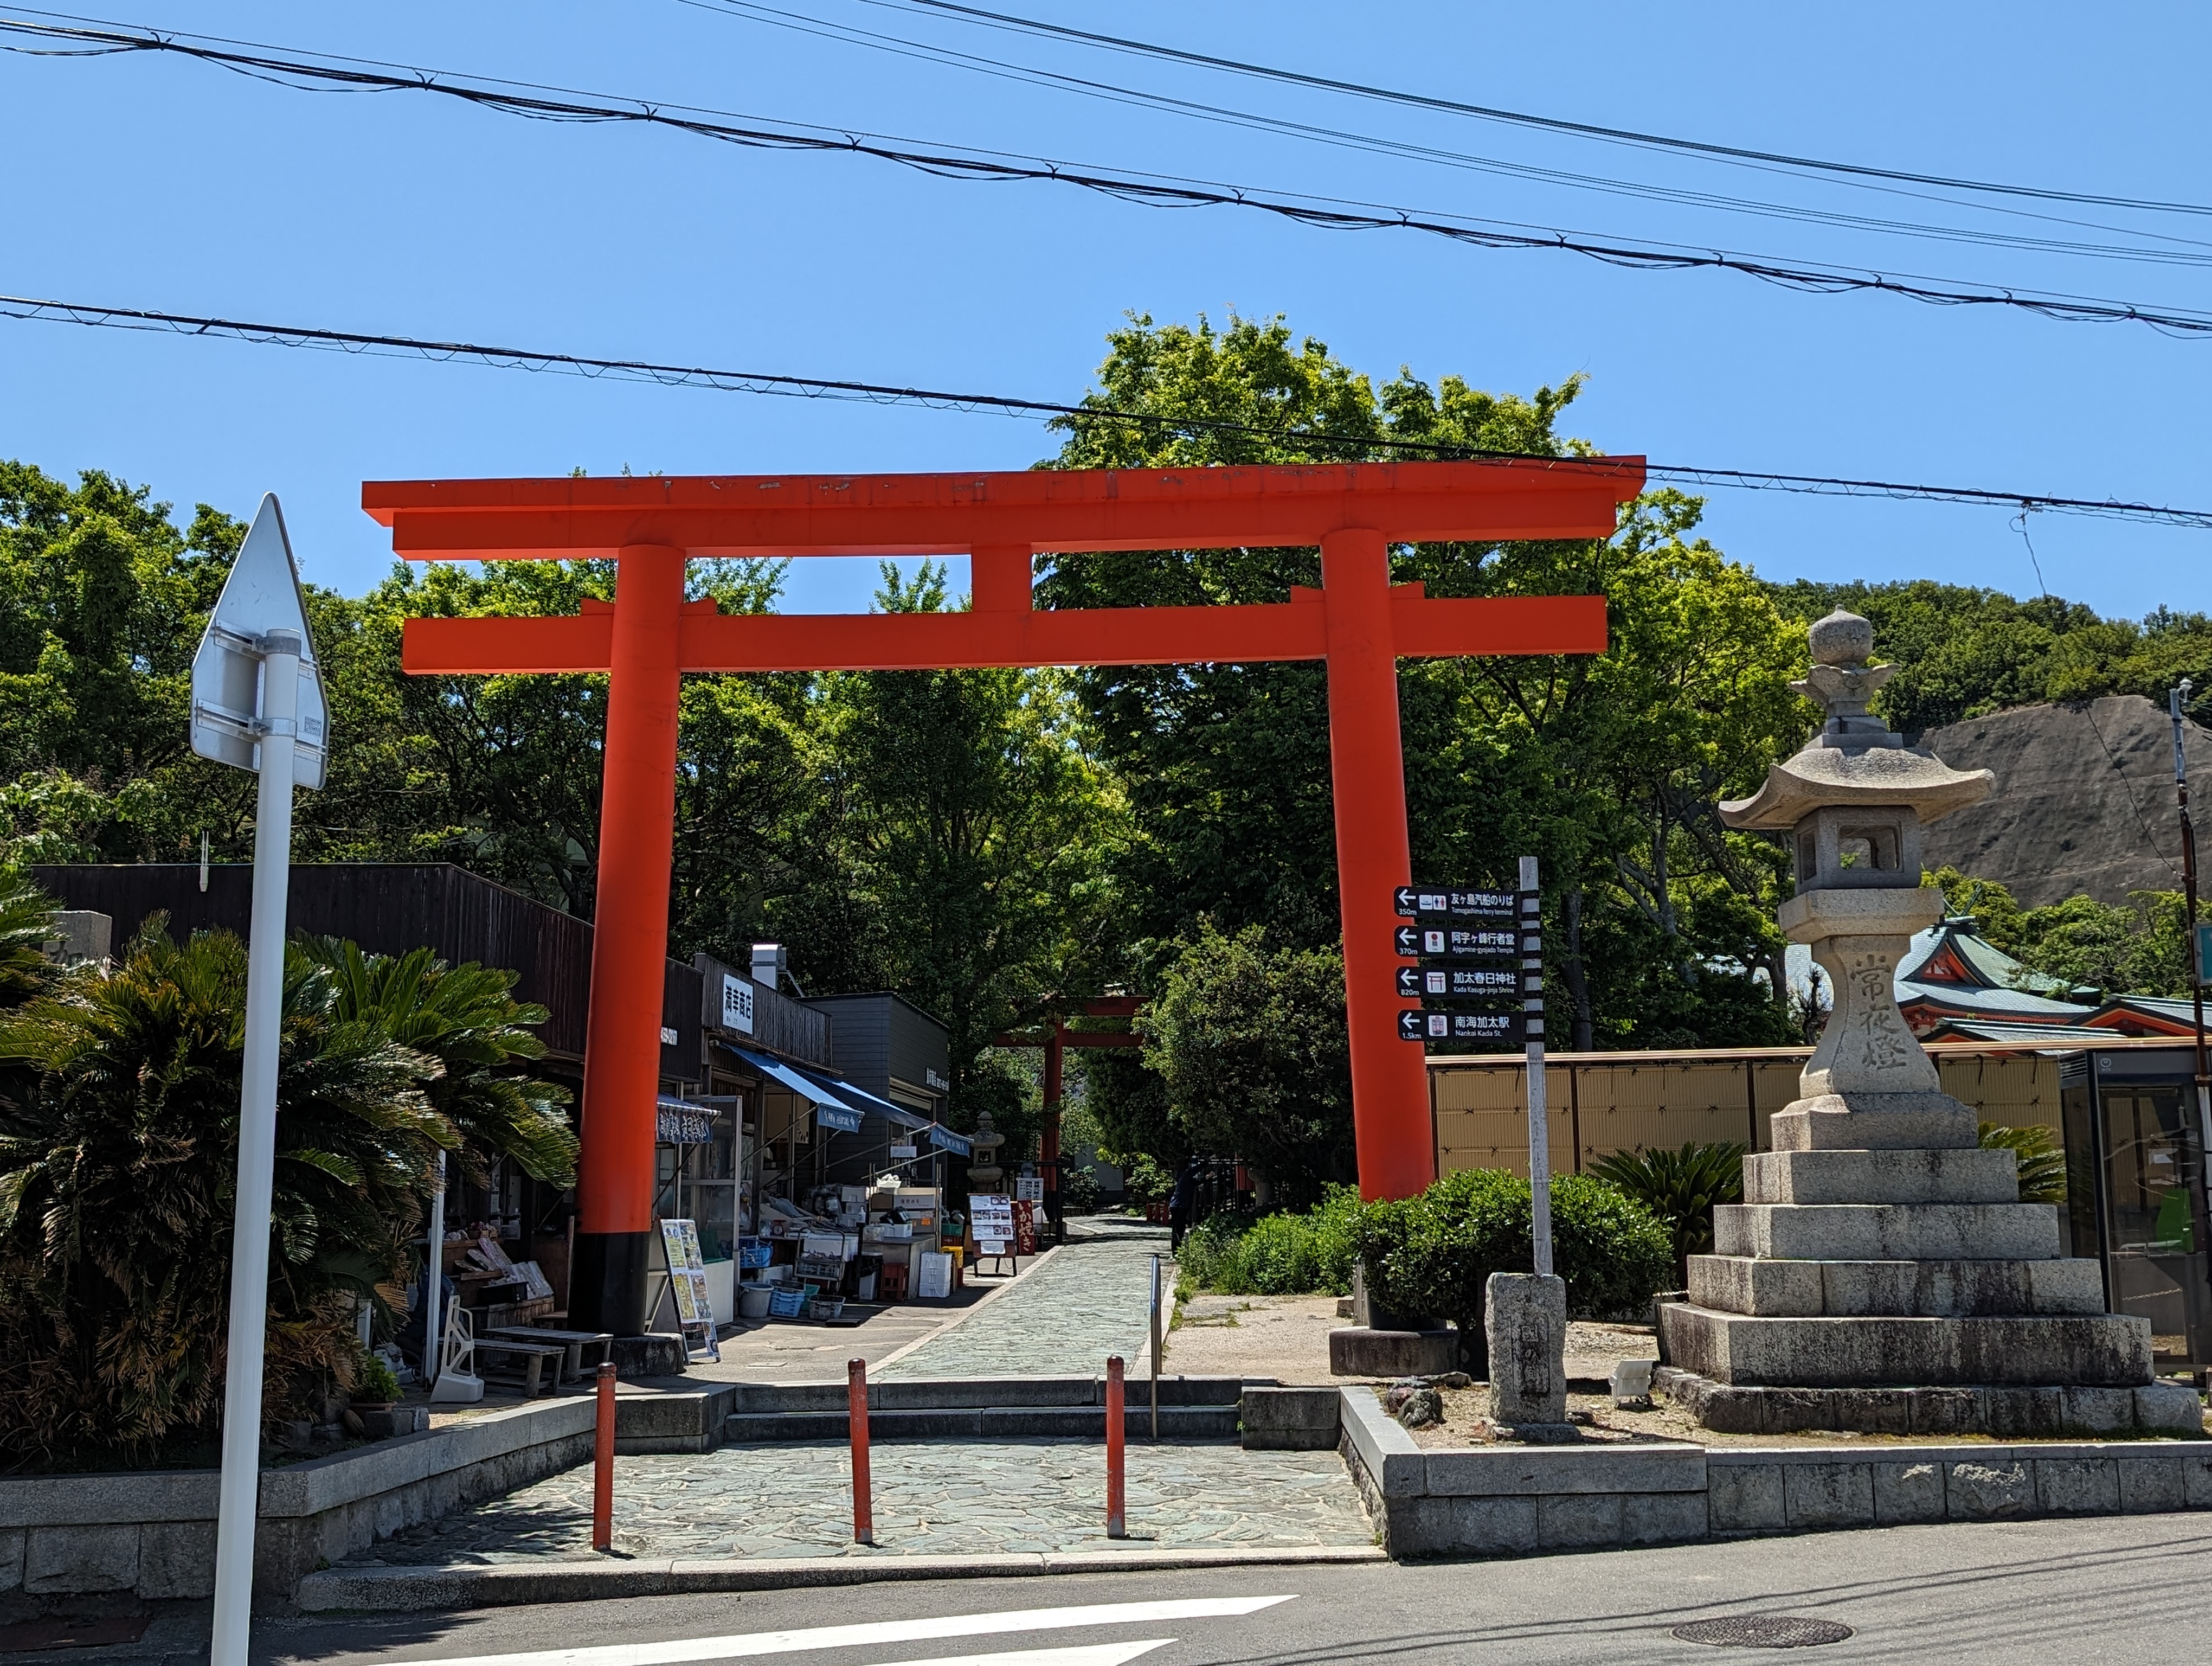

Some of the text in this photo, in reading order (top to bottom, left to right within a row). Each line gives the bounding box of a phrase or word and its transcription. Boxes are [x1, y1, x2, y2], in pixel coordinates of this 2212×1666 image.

[1454, 972, 1517, 984] 加太春日神社
[1455, 1016, 1510, 1028] 南海加太駅
[1018, 1202, 1034, 1252] いか焼き
